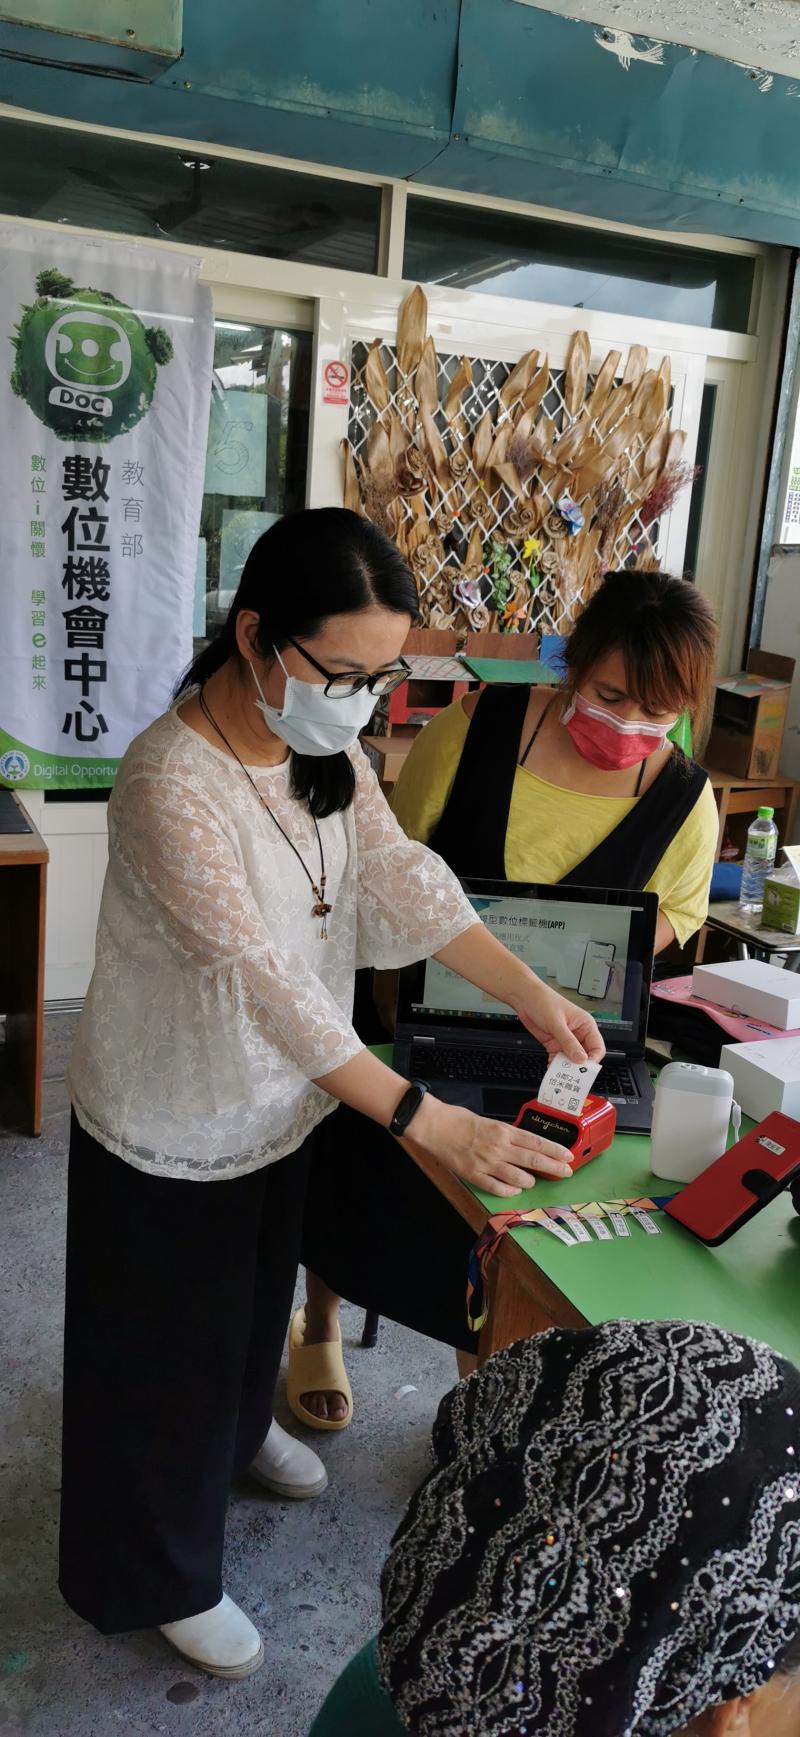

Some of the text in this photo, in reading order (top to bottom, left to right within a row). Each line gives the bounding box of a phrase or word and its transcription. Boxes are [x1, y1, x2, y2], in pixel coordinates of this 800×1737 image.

[60, 389, 105, 412] DOC
[214, 420, 253, 476] 5
[121, 459, 144, 558] 教育部
[31, 454, 47, 691] 數位i關懷 學習e起來
[61, 454, 111, 743] 數位機會中心
[34, 764, 68, 779] Digital
